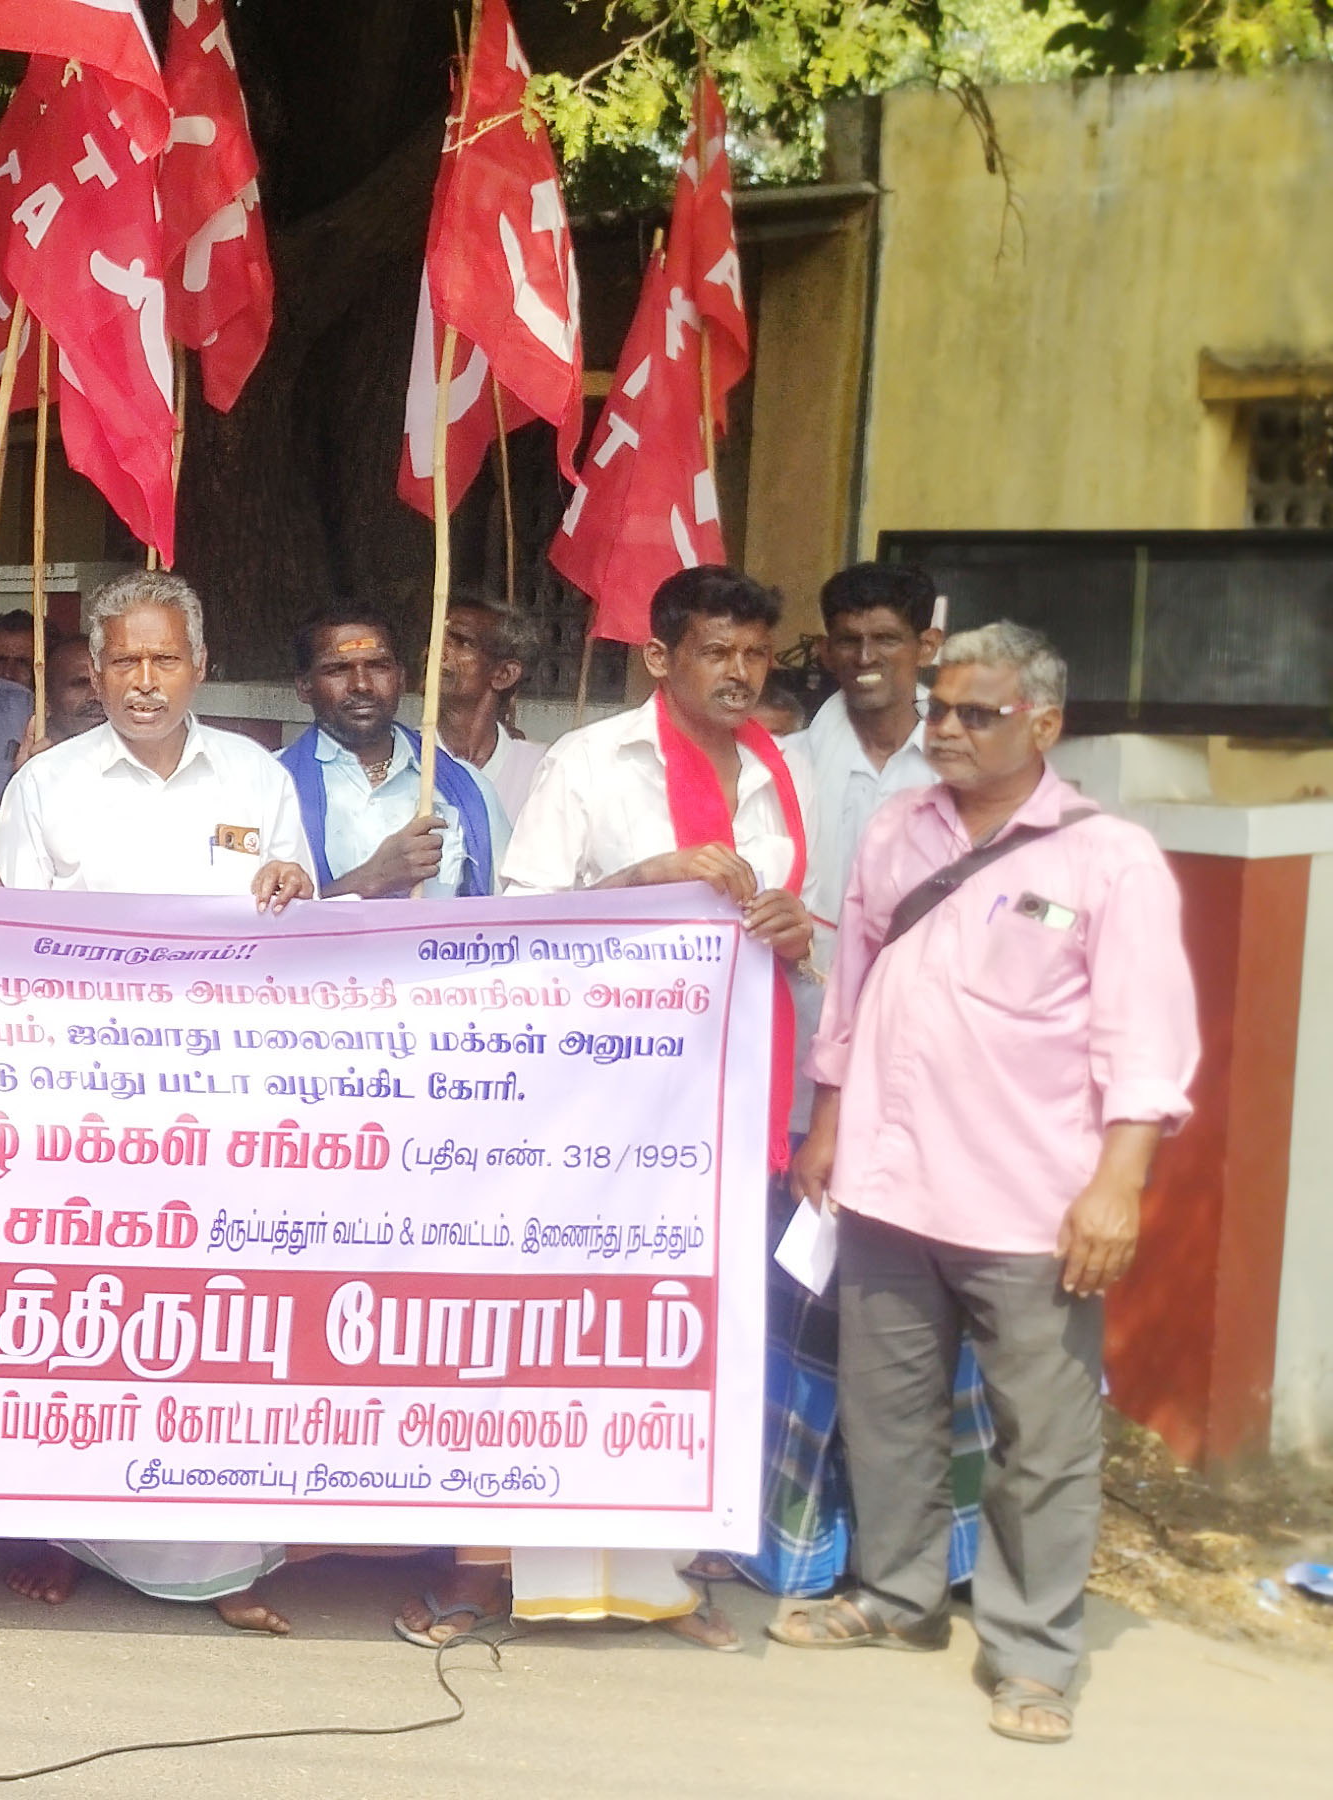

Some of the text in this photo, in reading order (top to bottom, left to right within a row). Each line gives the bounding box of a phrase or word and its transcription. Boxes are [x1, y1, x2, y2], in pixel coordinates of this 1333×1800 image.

[34, 936, 257, 966] போராடுவோம்!!
[418, 933, 721, 967] வெற்றி பெறுவோம்!!!
[183, 974, 397, 1010] அமல்படுத்தி
[410, 977, 569, 1011] வனநிலம்
[584, 979, 710, 1015] அளவீடு
[67, 1017, 221, 1056] ஜவ்வாது
[233, 1022, 416, 1059] மலைவாழ்
[431, 1022, 547, 1054] மக்கள்
[559, 1031, 684, 1064] அனுபவ
[30, 1062, 145, 1100] செய்து
[159, 1071, 250, 1094] பட்டா
[266, 1069, 415, 1104] வழங்கிட
[428, 1071, 525, 1101] கோரி.
[36, 1113, 210, 1166] மக்கள்
[227, 1119, 390, 1170] சங்கம்
[402, 1140, 478, 1174] (பதிவு
[486, 1139, 553, 1168] எண்.
[4, 1196, 198, 1248] சங்கம்
[207, 1209, 328, 1255] திருப்பத்தூர்
[333, 1212, 393, 1244] வட்டம்
[400, 1217, 414, 1245] &
[422, 1213, 515, 1247] மாவட்டம்.
[521, 1215, 622, 1259] இணைந்து
[625, 1214, 704, 1260] நடத்தும்
[326, 1281, 703, 1379] போராட்டம்
[156, 1396, 385, 1446] கோட்டாட்சியர்
[398, 1400, 587, 1452] அலுவலகம்
[603, 1402, 706, 1460] முன்பு.
[126, 1459, 559, 1497] (தீயணைப்பு நிலையம் அருகில்)
